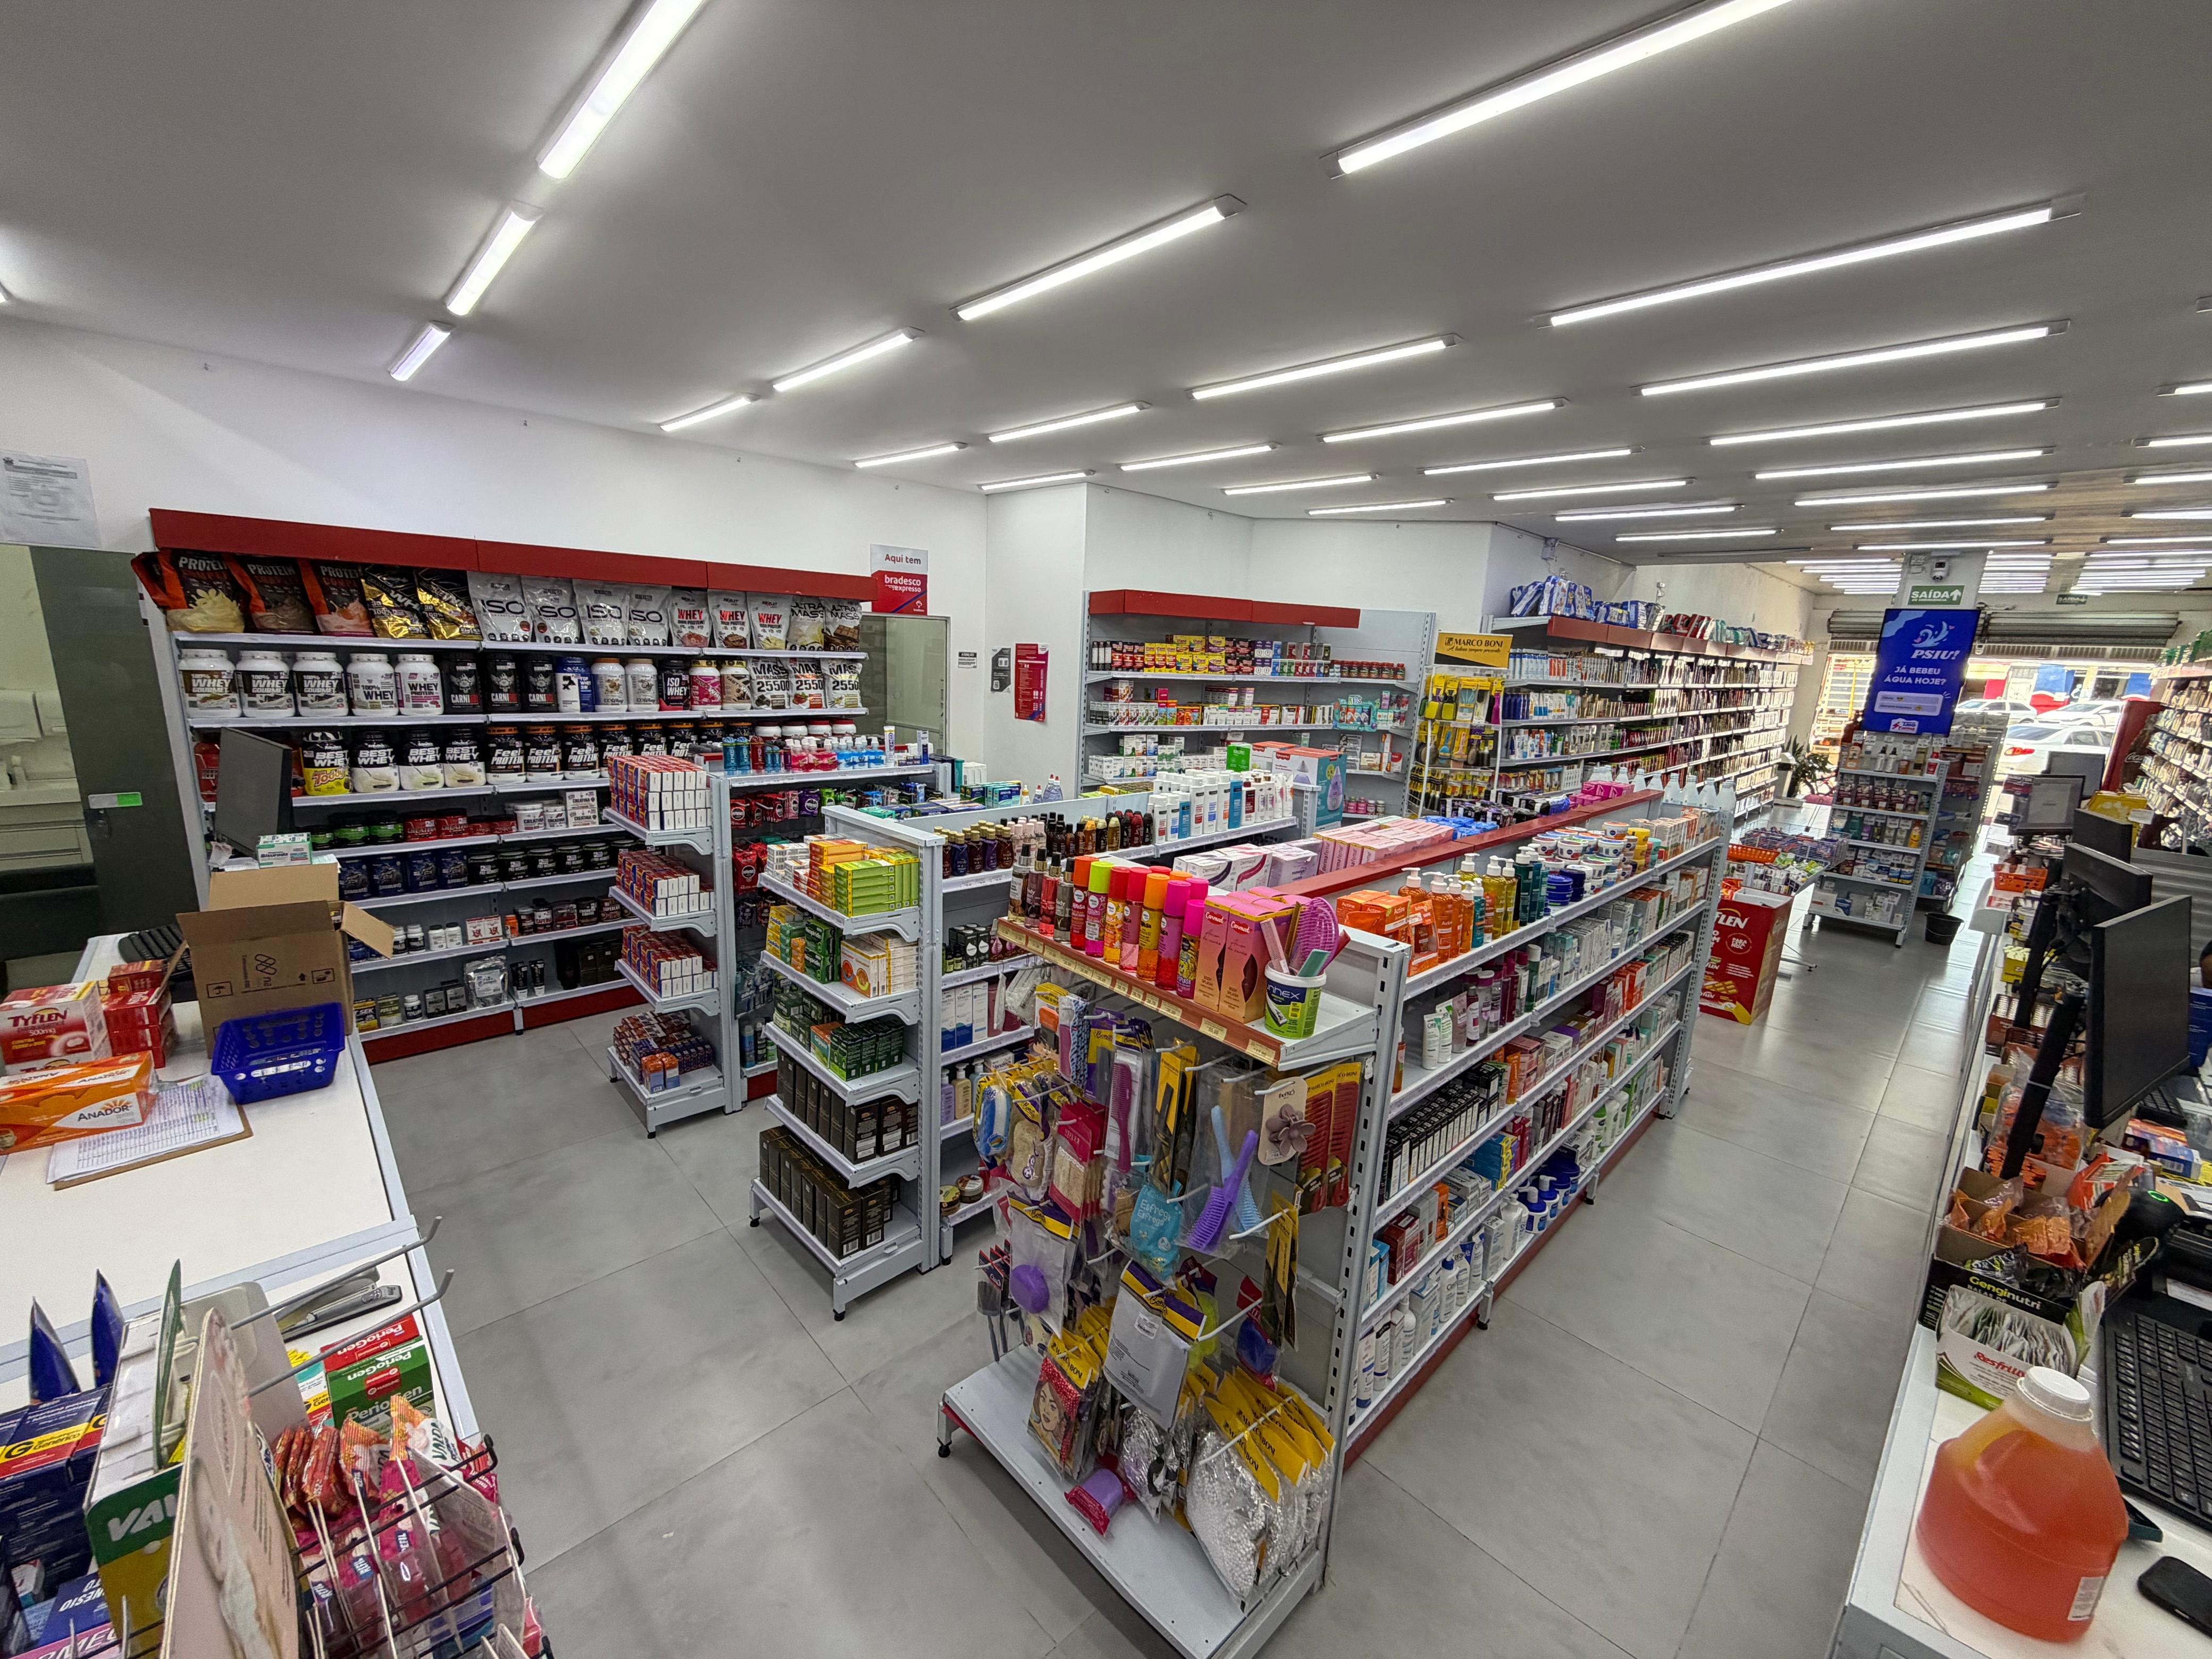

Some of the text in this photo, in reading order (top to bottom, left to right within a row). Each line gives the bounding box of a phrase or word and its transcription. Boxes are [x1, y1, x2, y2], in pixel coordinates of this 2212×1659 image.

[885, 554, 921, 565] Aqui tem
[247, 564, 296, 576] PROTEIN
[884, 574, 921, 586] bradesco
[1911, 589, 1950, 599] SAÍDA
[480, 599, 525, 615] ISO
[535, 605, 576, 619] ISO
[587, 604, 622, 619] ISO
[629, 610, 663, 623] ISO
[678, 609, 703, 620] WHEY
[719, 610, 745, 621] WHEY
[758, 612, 782, 624] WHEY
[830, 611, 860, 620] MASS
[1454, 638, 1482, 647] MARCO
[1911, 649, 1960, 660] PSIU!
[1894, 665, 1906, 674] JÁ
[191, 678, 231, 688] WHEY
[252, 680, 288, 689] WHEY
[304, 680, 339, 689] WHEY
[667, 677, 680, 686] ISO
[795, 680, 824, 691] 2550
[832, 681, 859, 691] 2550
[1914, 677, 1947, 685] HOJE?
[408, 683, 438, 691] WHEY
[667, 686, 688, 696] WHEY
[364, 691, 394, 700] WHEY
[358, 748, 393, 757] BEST
[409, 747, 440, 755] BEST
[446, 746, 478, 755] BEST
[529, 747, 555, 756] Feel
[571, 747, 594, 755] Feel
[605, 743, 630, 752] Feel
[315, 750, 349, 760] BEST
[408, 753, 441, 763] WHEY
[445, 752, 480, 761] WHEY
[494, 749, 522, 757] Feel
[671, 749, 690, 757] PROT
[314, 758, 350, 767] WHEY
[357, 755, 395, 765] WHEY
[313, 768, 345, 786] Toddy
[1205, 912, 1224, 924] Carmed
[1230, 921, 1250, 933] Carmed
[7, 1009, 68, 1028] TYFLEN
[29, 1028, 56, 1037] 500mg
[78, 1105, 131, 1122] ANADOR
[337, 1323, 405, 1356] PerioGen
[347, 1351, 412, 1381] PerioGen
[348, 1386, 423, 1420] Perioen
[5, 1433, 81, 1459] G Genérico
